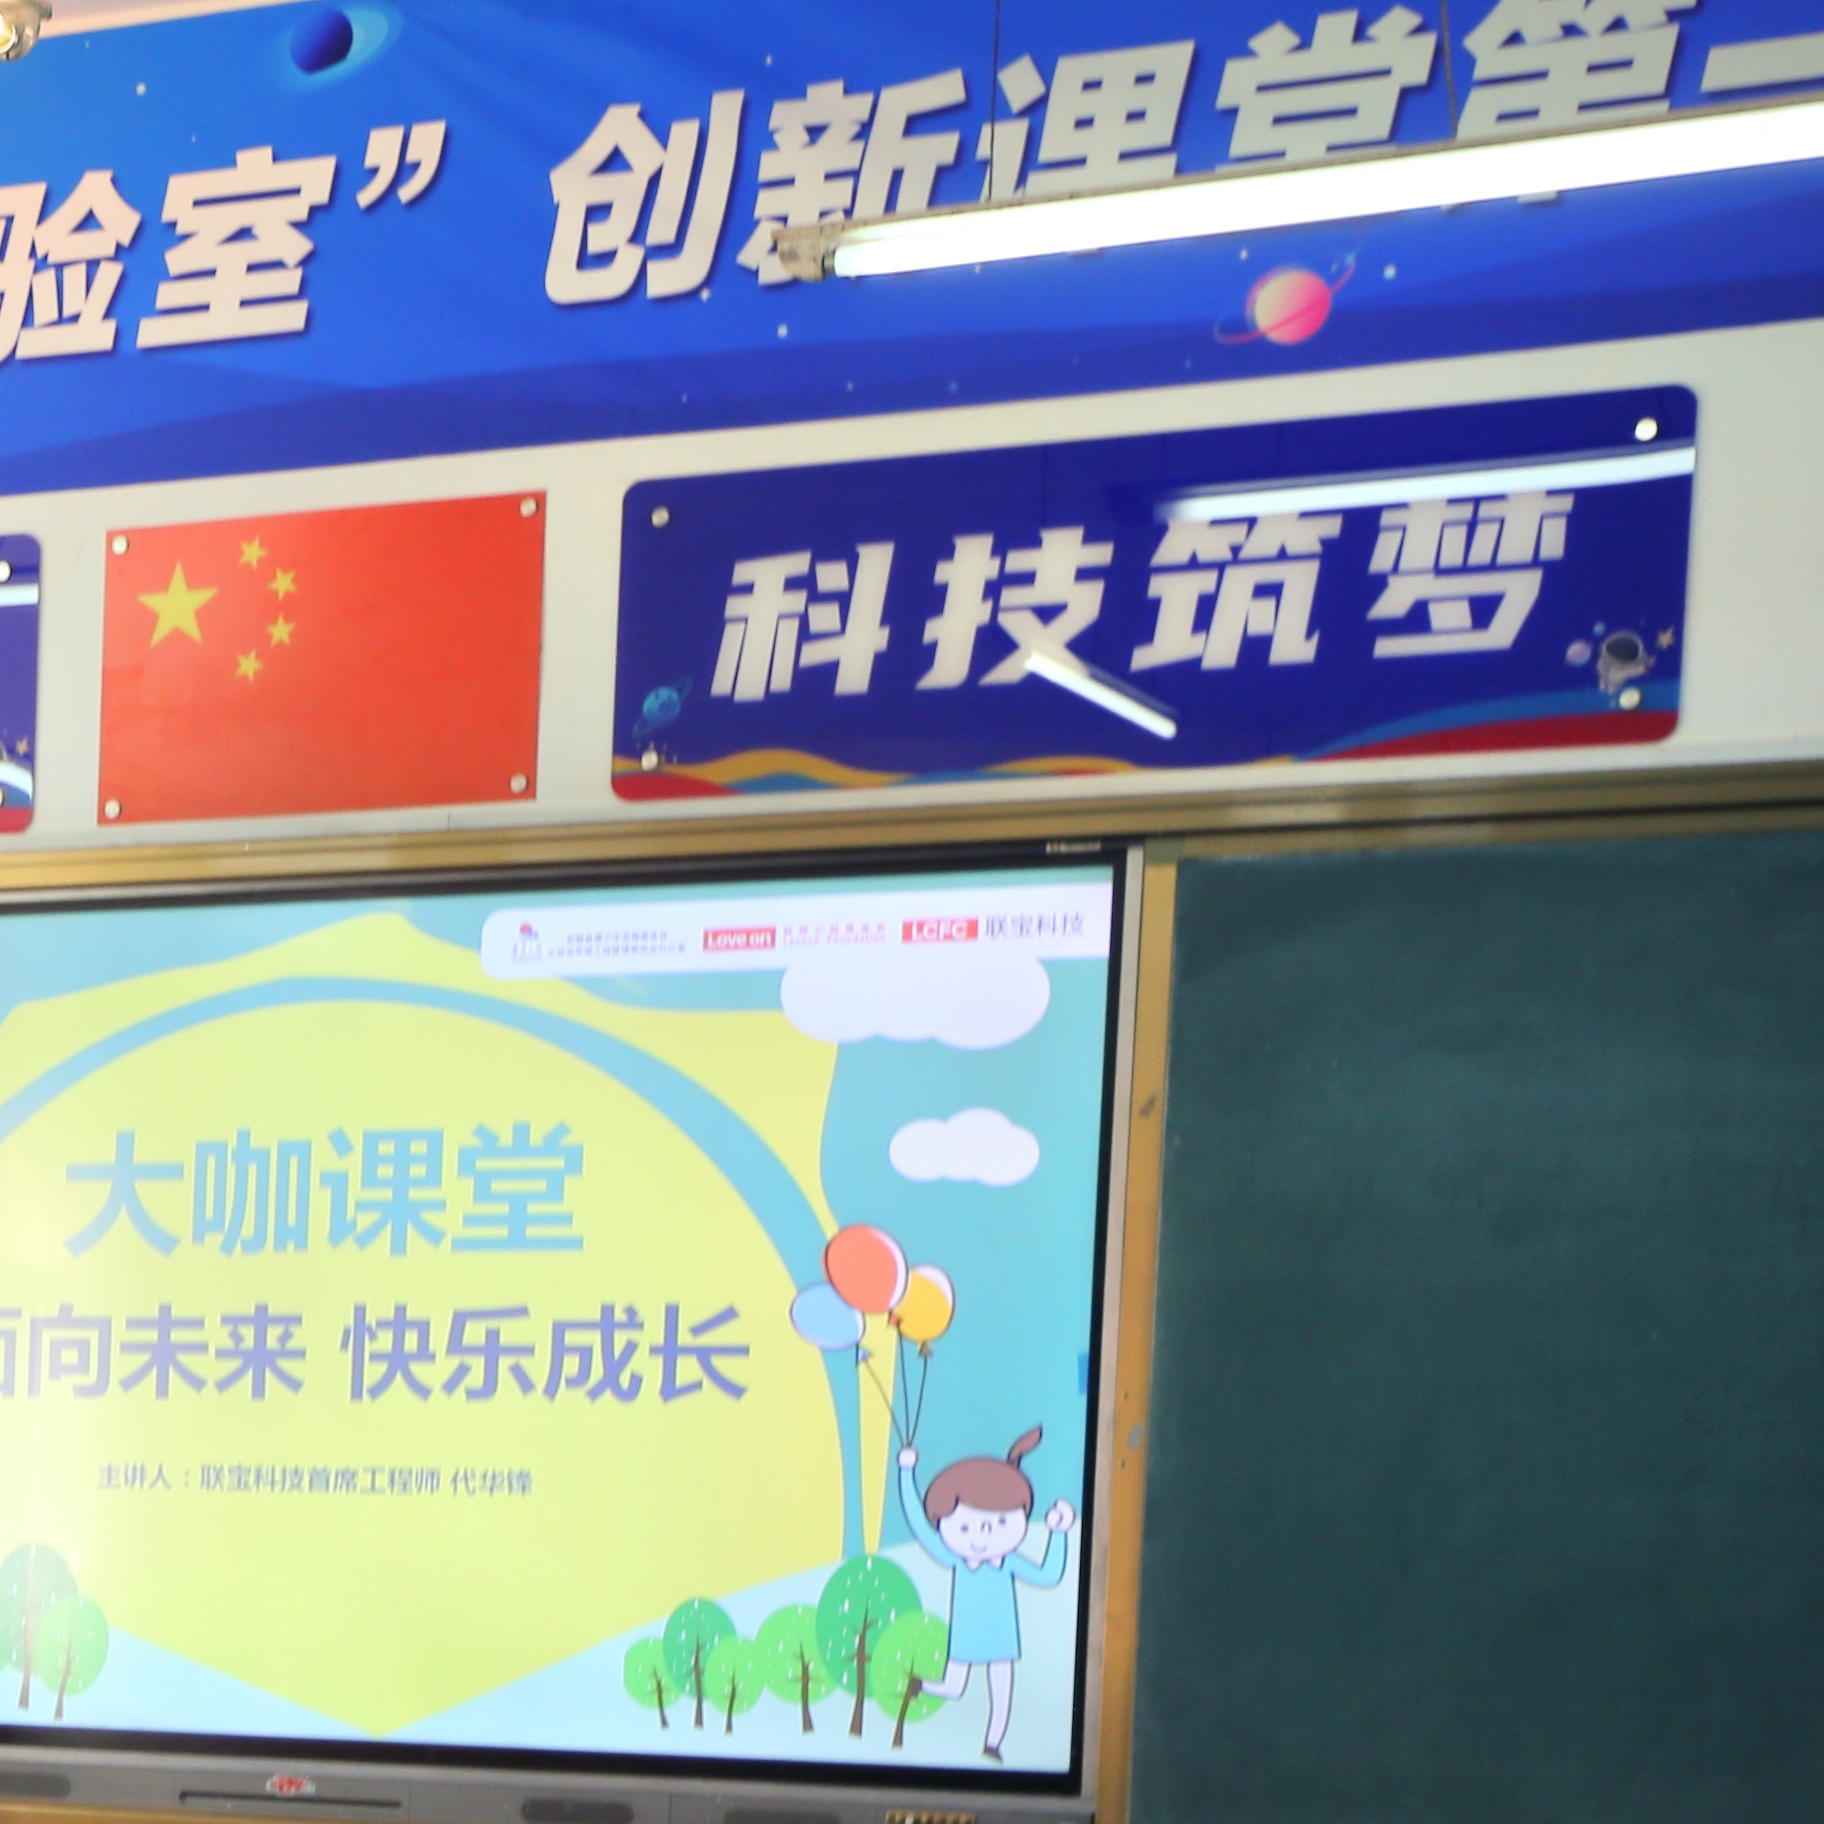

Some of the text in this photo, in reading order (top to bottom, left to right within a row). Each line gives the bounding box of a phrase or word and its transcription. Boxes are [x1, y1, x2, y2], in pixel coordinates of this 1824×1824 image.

[710, 491, 1575, 702] 科技筑梦
[707, 929, 747, 950] Love
[749, 928, 772, 948] on
[910, 919, 968, 941] LCFC
[984, 911, 1084, 939] 联宝科技
[63, 1122, 587, 1260] 大咖课堂
[341, 1304, 751, 1404] 快乐成长
